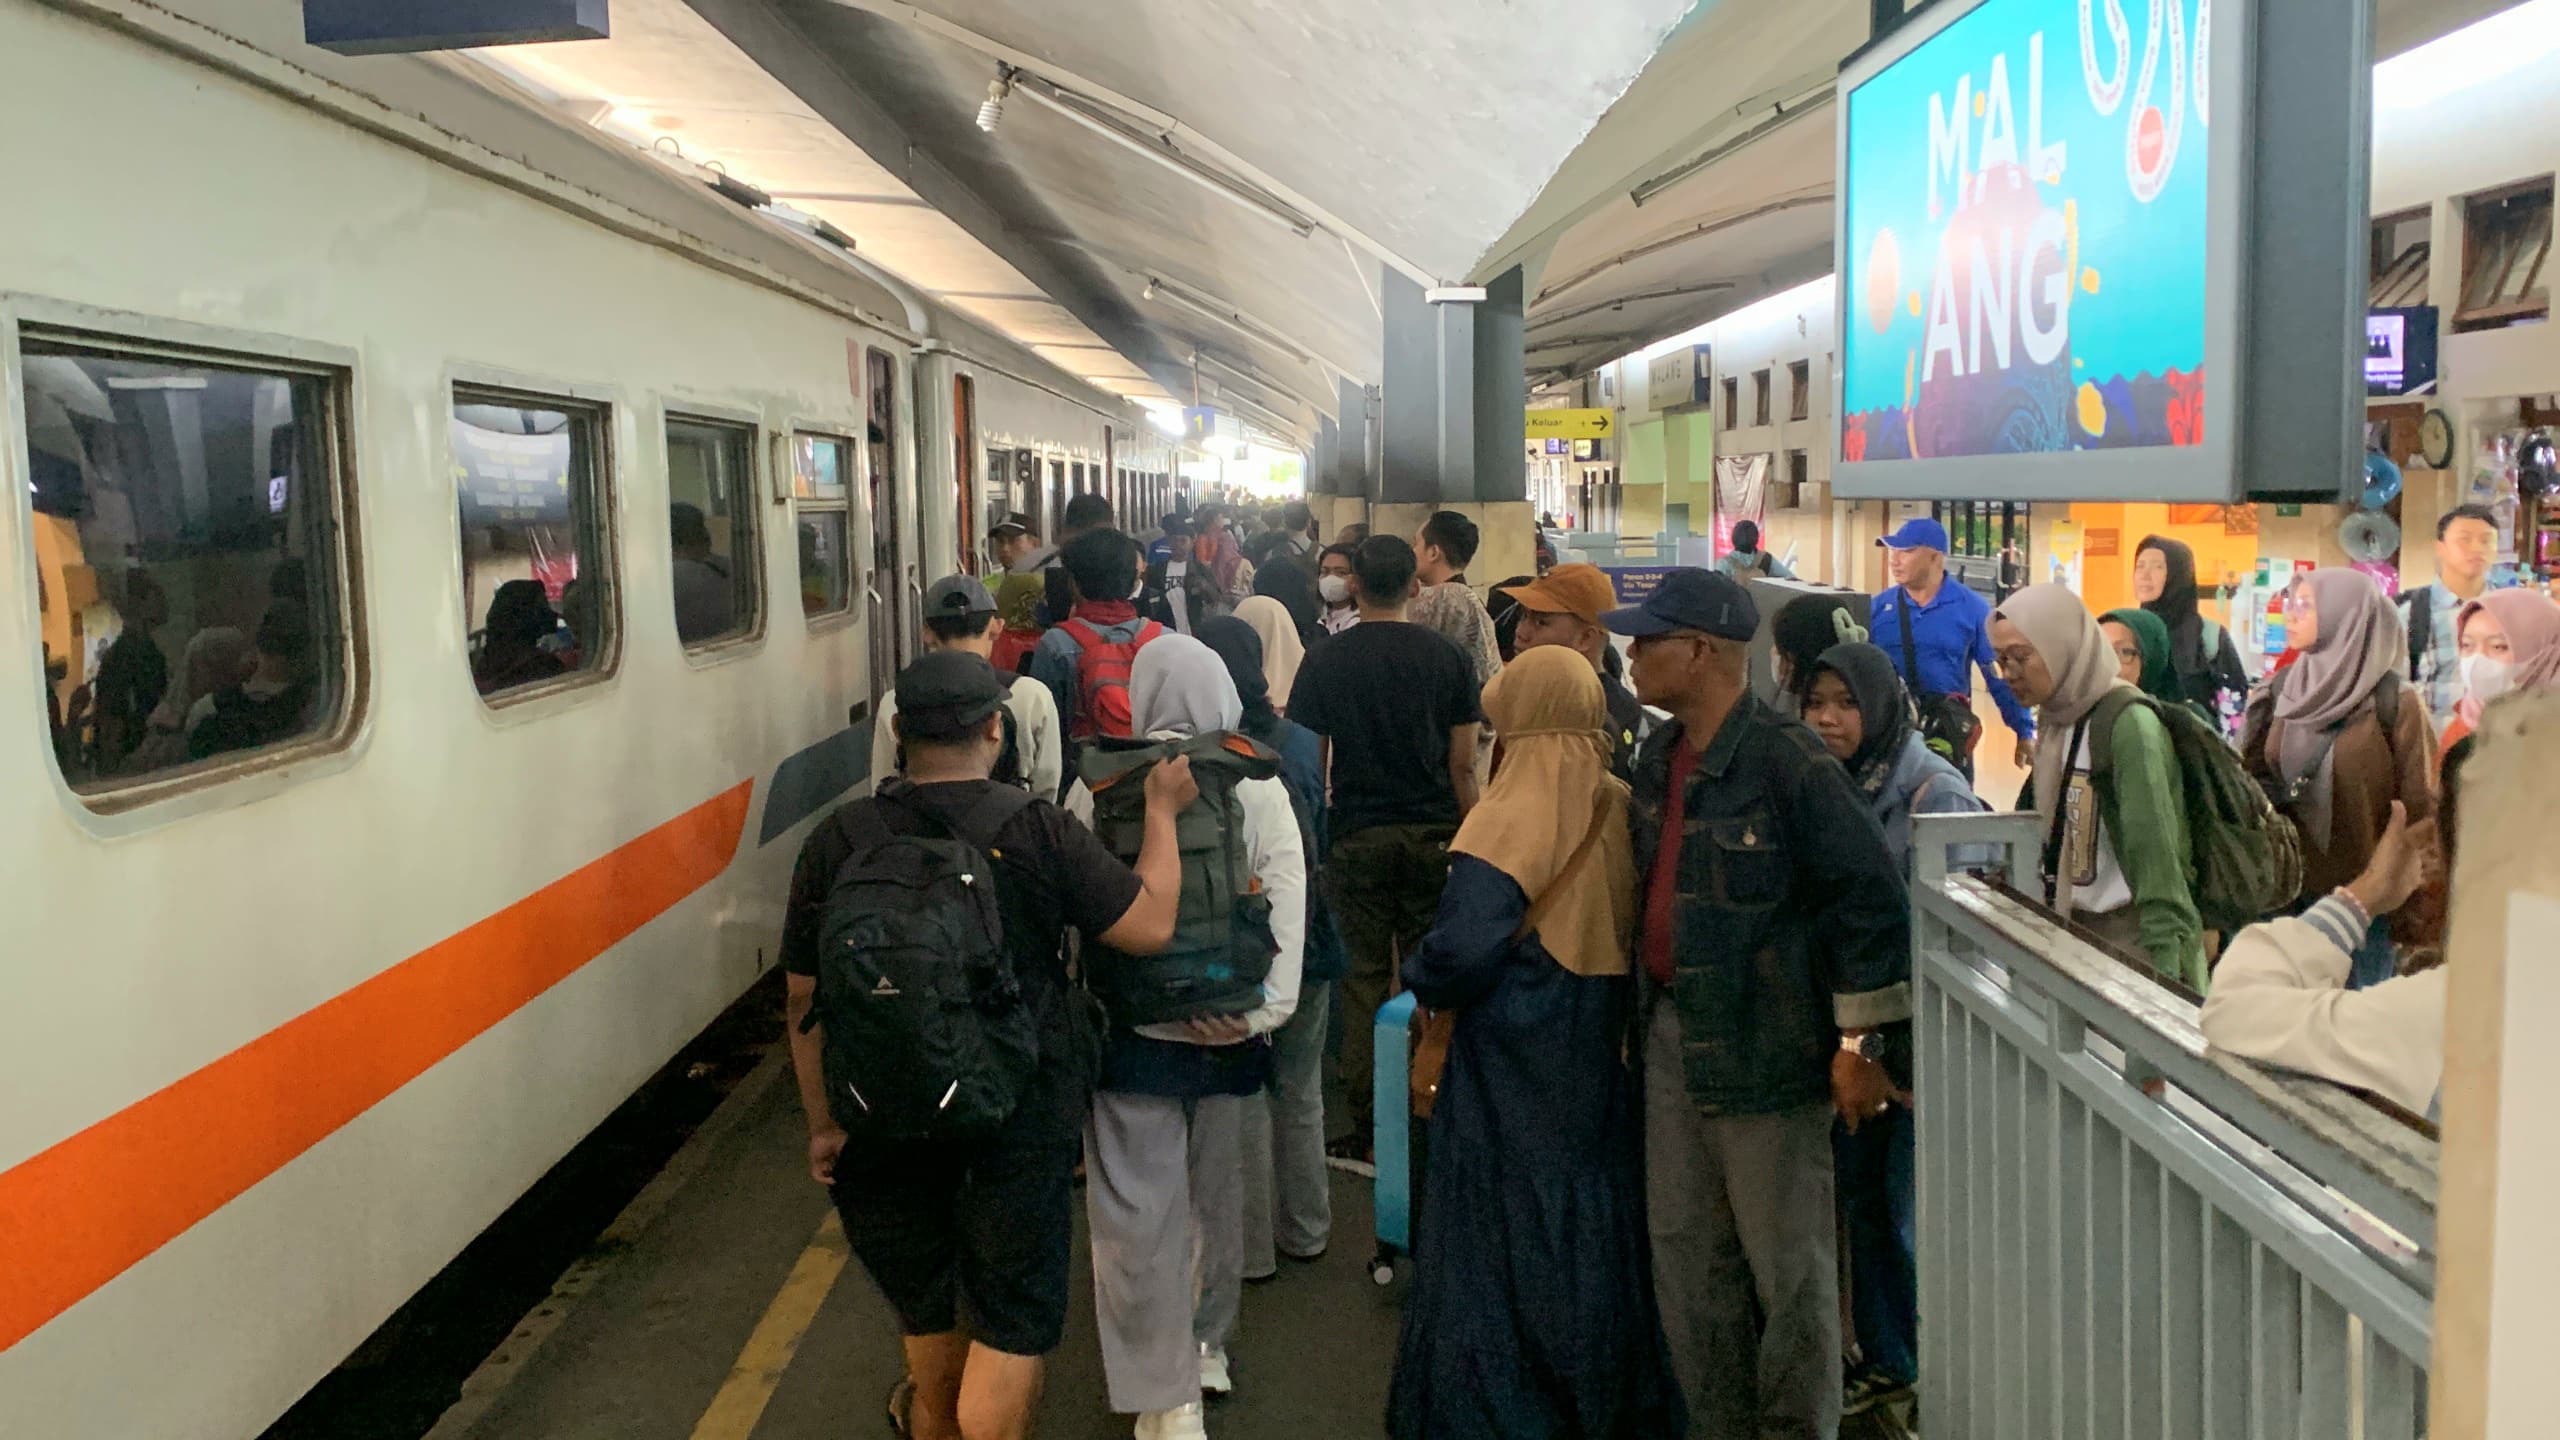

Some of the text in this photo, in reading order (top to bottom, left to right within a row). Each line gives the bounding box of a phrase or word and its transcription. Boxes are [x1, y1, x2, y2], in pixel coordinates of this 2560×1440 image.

[1928, 30, 2067, 222] MAL
[1922, 207, 2069, 382] ANG
[1193, 414, 1203, 432] 1
[1532, 418, 1562, 427] Keluar
